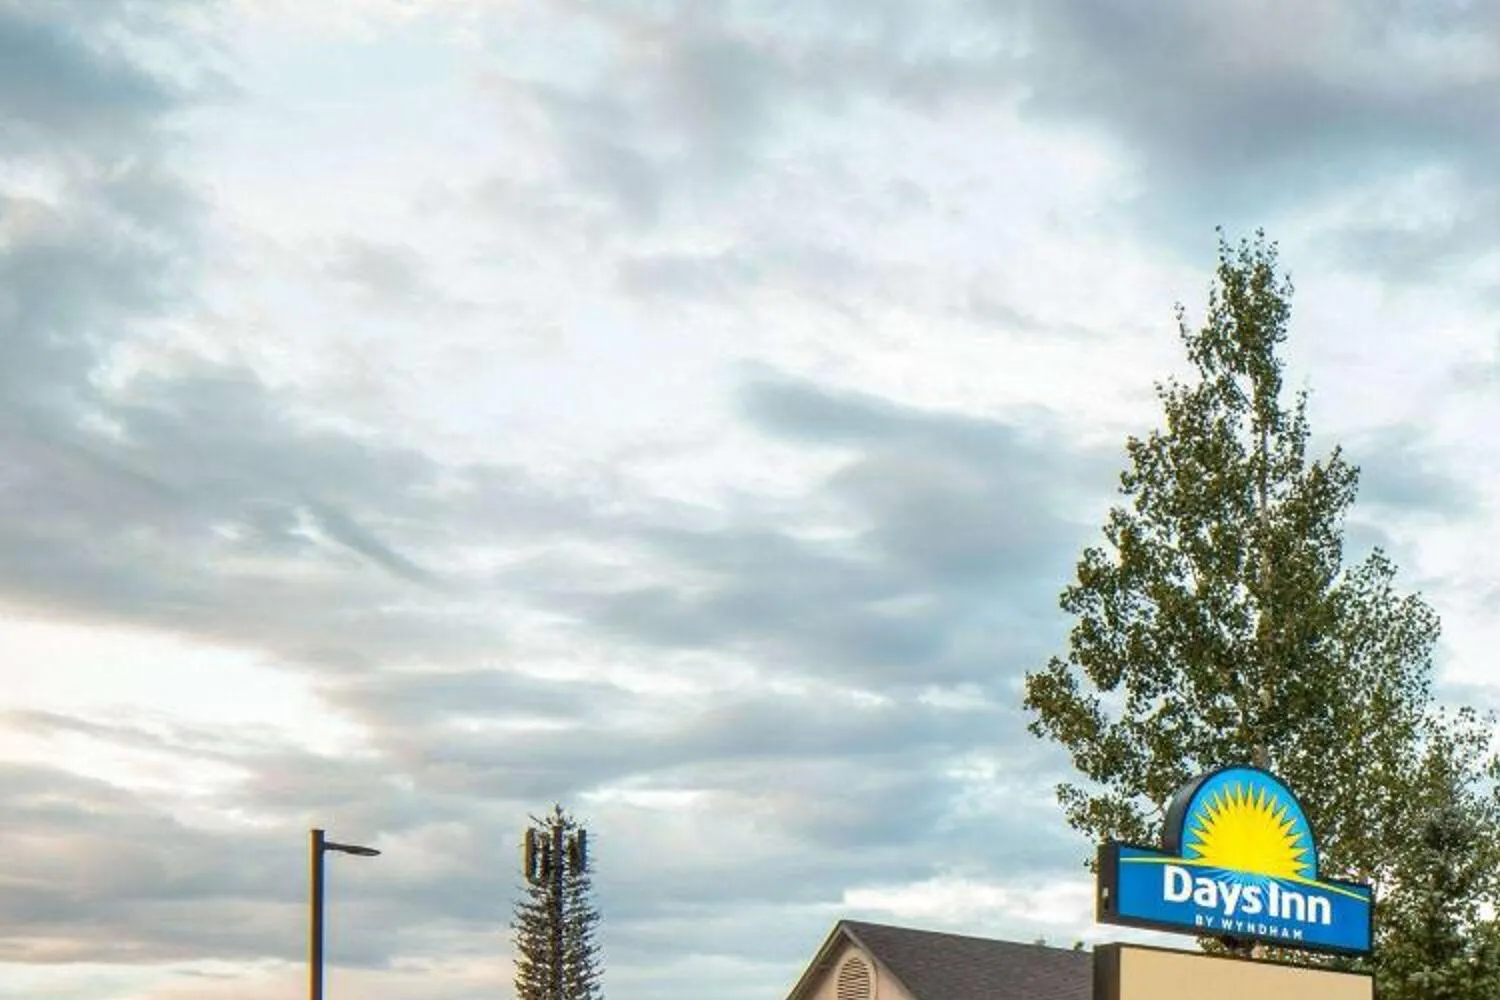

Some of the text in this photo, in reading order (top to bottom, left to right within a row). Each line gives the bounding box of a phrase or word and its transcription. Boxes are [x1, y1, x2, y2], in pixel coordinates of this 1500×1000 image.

[1164, 864, 1331, 925] Days Inn
[1195, 914, 1303, 940] BY WYNDHAM
